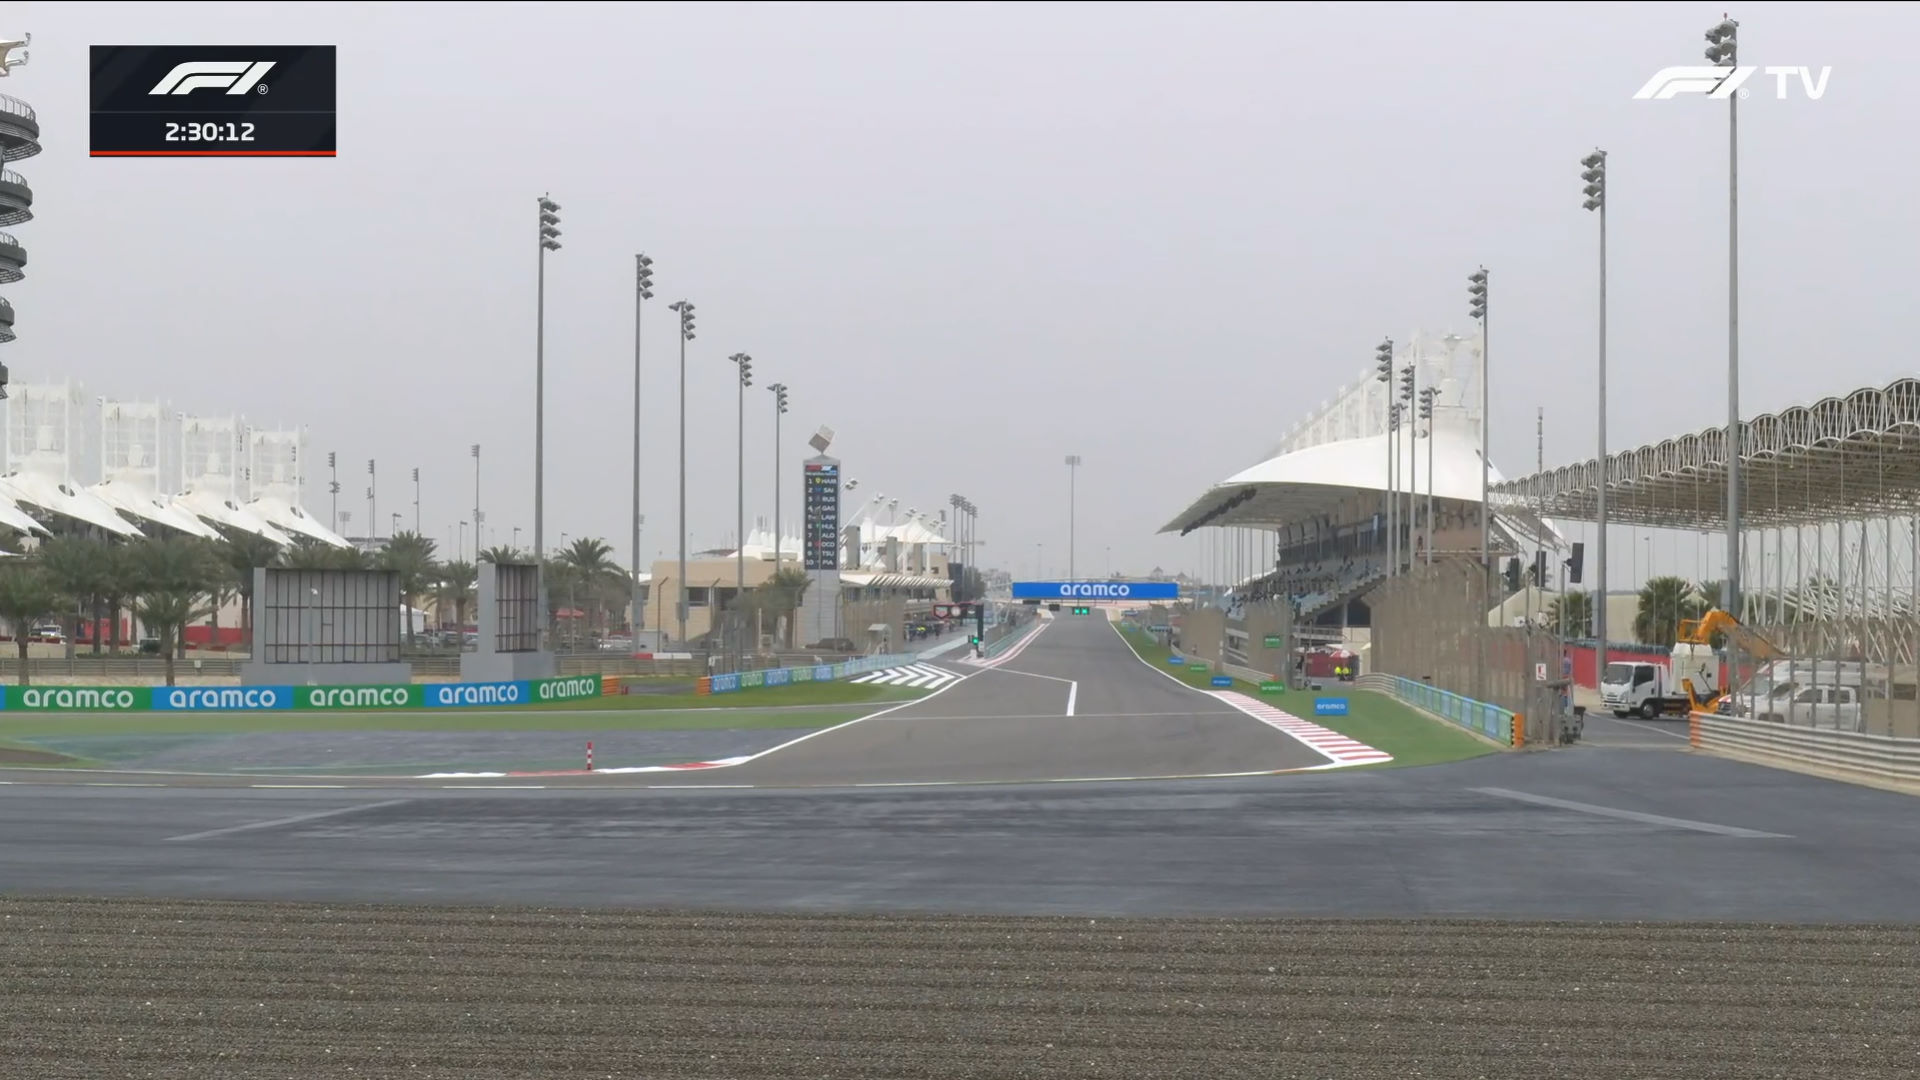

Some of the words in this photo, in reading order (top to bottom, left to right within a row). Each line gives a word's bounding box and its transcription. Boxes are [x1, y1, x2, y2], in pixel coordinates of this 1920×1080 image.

[1060, 583, 1130, 596] aramco
[309, 687, 408, 706] aramco
[439, 684, 519, 705] aramco
[539, 678, 595, 698] aramco
[23, 689, 134, 708] aramco
[169, 689, 276, 708] aramco
[1316, 702, 1346, 710] aramco
